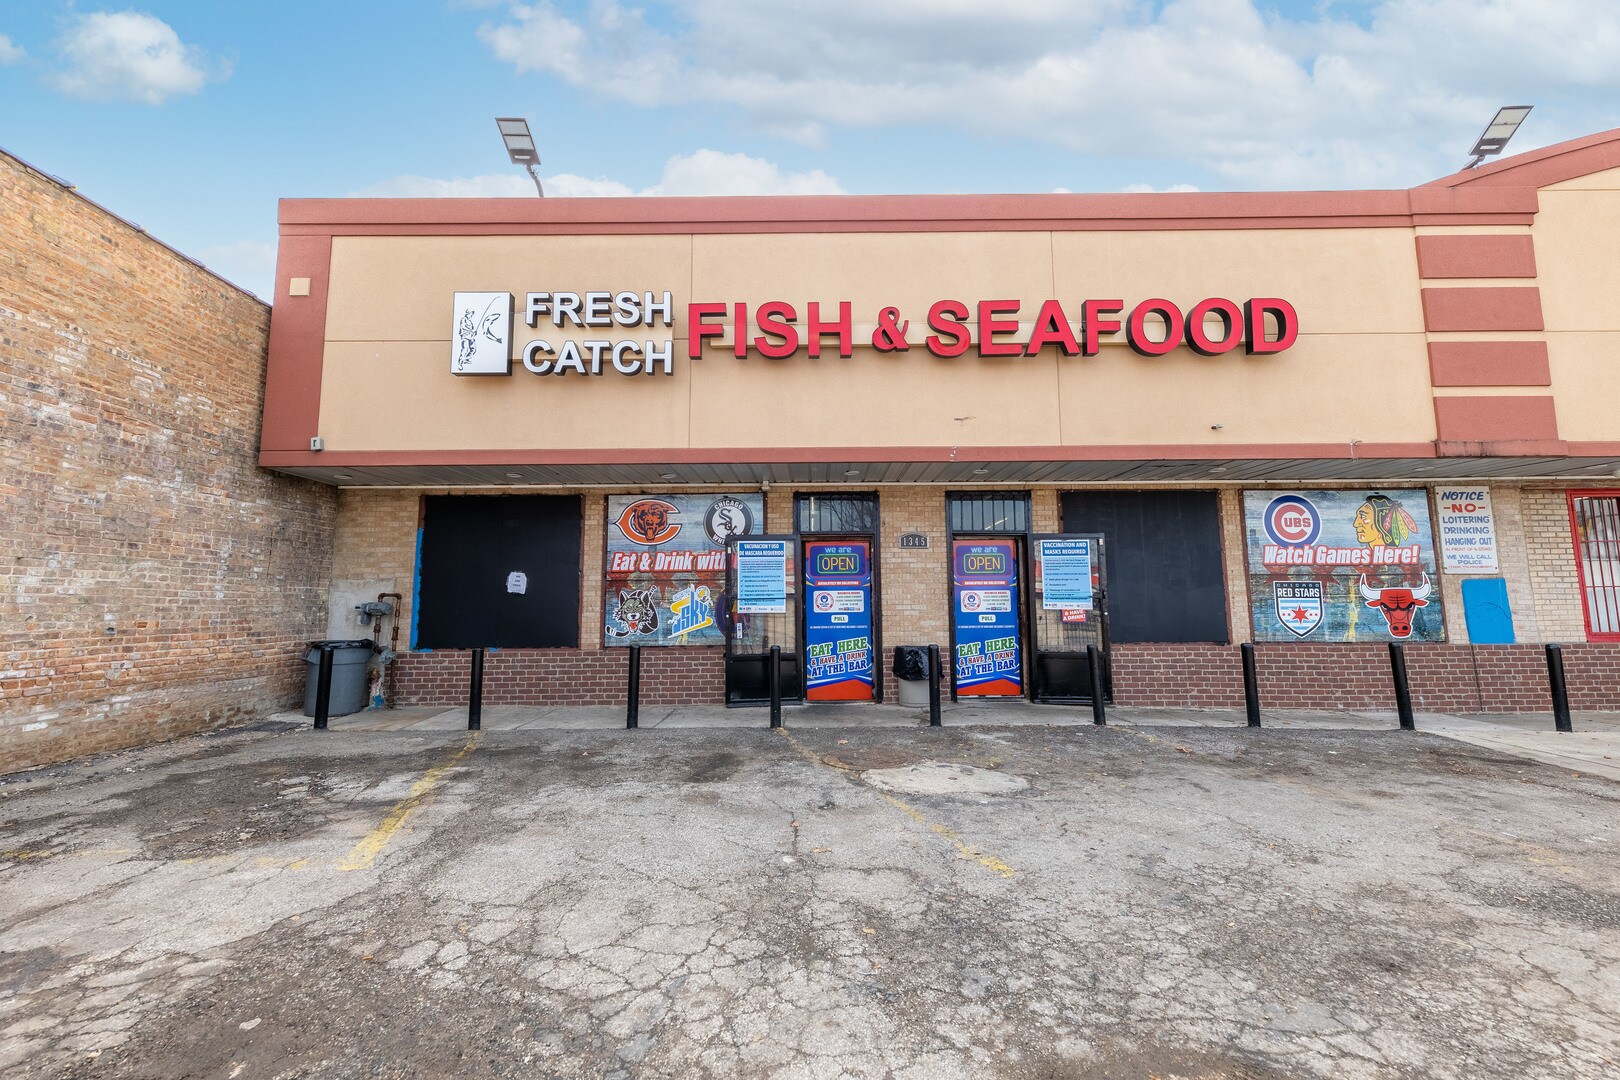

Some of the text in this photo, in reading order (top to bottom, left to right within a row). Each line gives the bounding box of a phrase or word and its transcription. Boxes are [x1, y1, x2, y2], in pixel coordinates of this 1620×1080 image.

[524, 290, 675, 328] FRESH
[687, 297, 1299, 361] FISH & SEAFOOD
[521, 339, 675, 377] CATCH
[1441, 491, 1484, 501] NOTICE
[714, 500, 744, 510] CHICAGO
[1273, 504, 1312, 541] CUBS
[1442, 516, 1490, 524] LOITERING
[903, 537, 925, 546] 1345
[1444, 537, 1493, 545] HANGING OUT
[611, 551, 637, 572] Eat
[639, 551, 651, 572] &
[654, 551, 694, 572] Drink
[1264, 545, 1419, 564] Watch Games Here!
[821, 556, 854, 571] OPEN
[967, 556, 1001, 571] OPEN
[1277, 588, 1320, 598] RED STARS
[681, 590, 708, 631] SKY
[810, 637, 867, 658] EAT HERE
[958, 636, 1015, 657] EAT HERE
[811, 651, 867, 666] & HAVE A DRINK
[959, 650, 1015, 666] & HAVE A DRINK
[811, 660, 867, 677] AT THE BAR
[960, 660, 1015, 677] AT THE BAR
